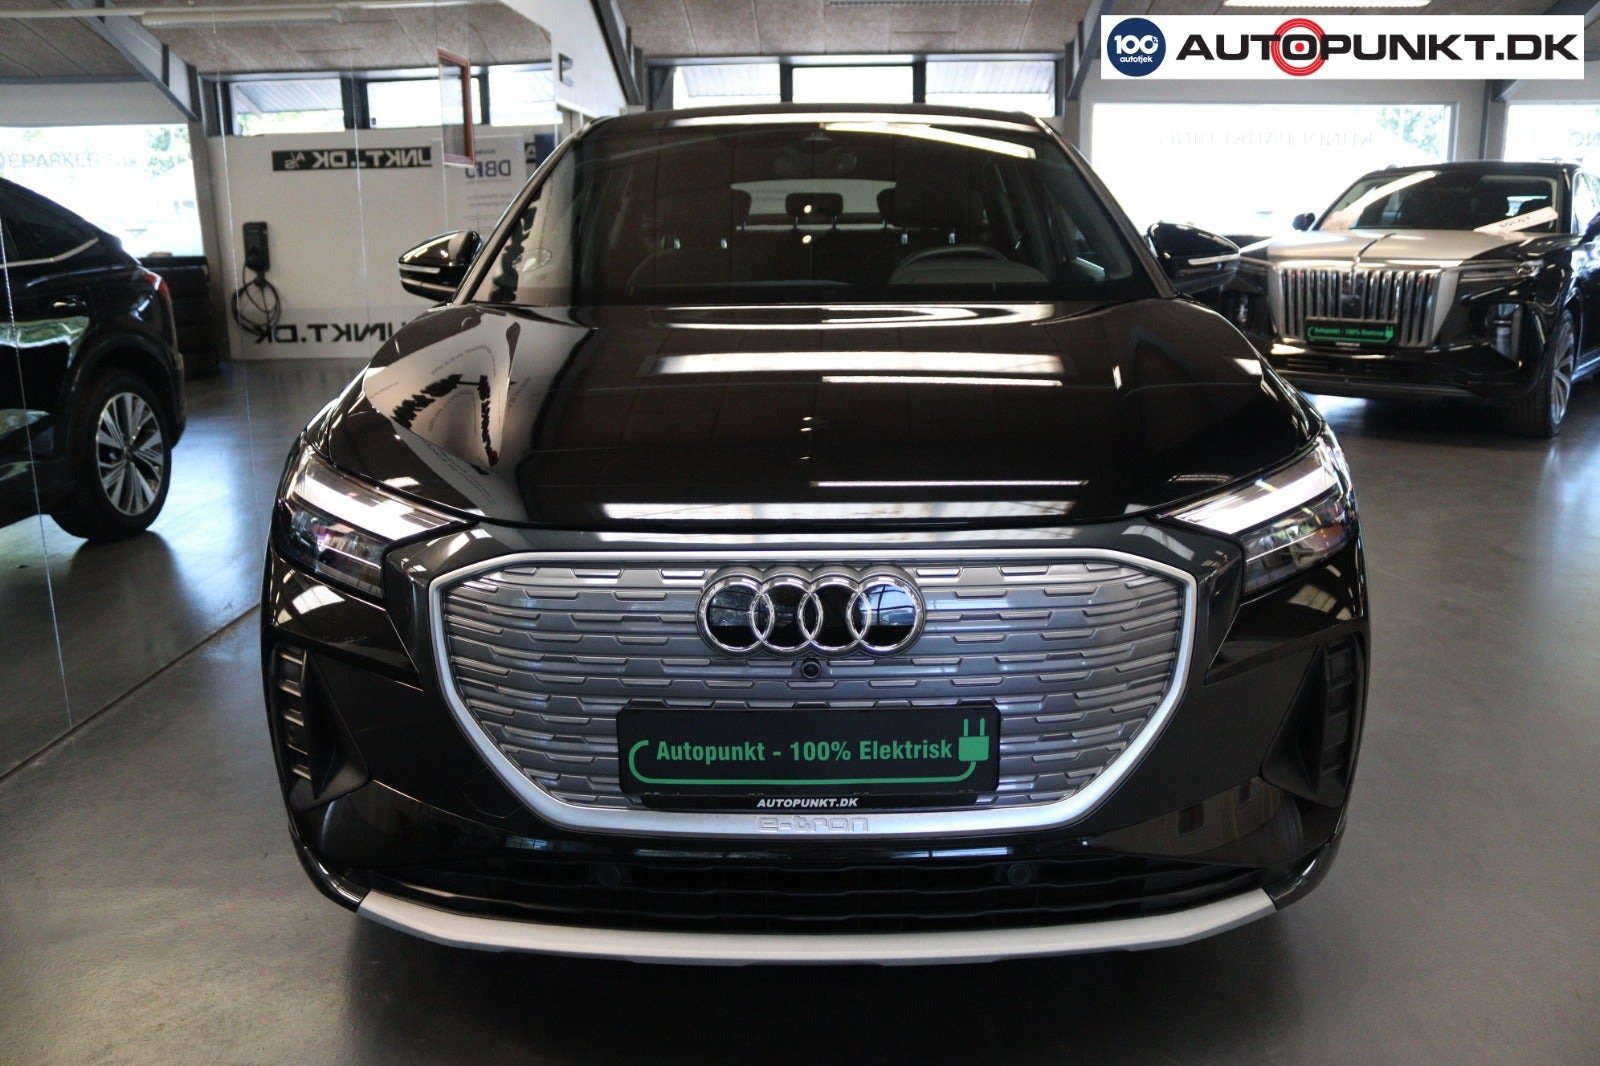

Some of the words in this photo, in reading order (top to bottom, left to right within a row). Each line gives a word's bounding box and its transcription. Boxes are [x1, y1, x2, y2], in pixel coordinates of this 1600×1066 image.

[656, 740, 765, 765] Autopunkt
[790, 741, 852, 761] 100%
[859, 739, 953, 760] Elektrisk
[757, 798, 859, 808] AUTOPUNKT.DK
[757, 815, 869, 833] e-tron
